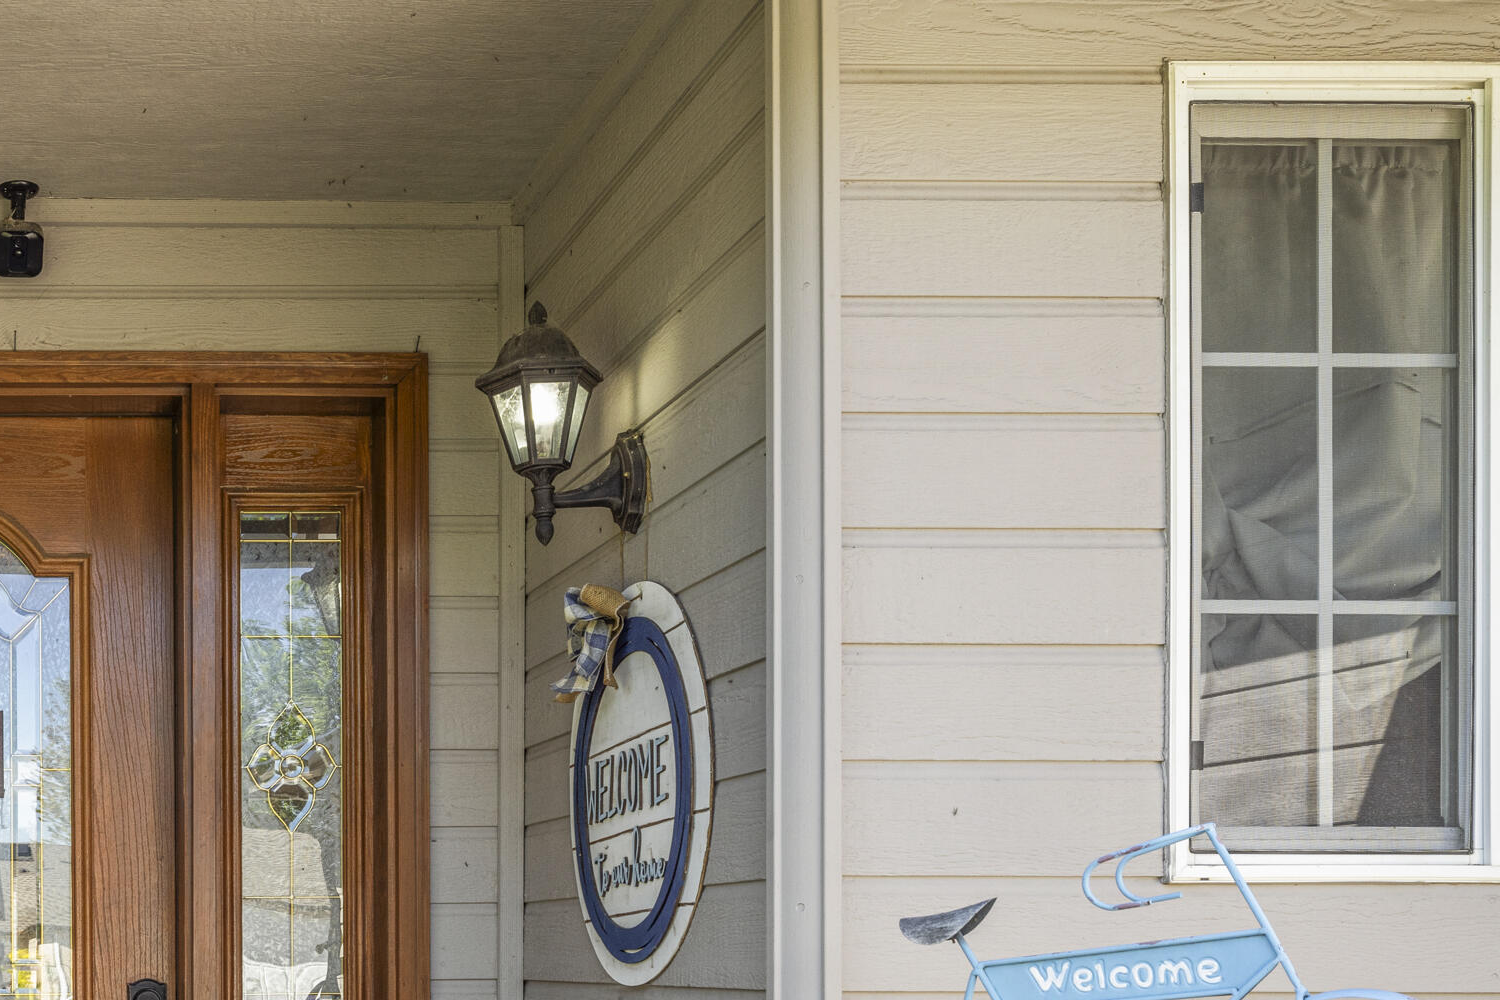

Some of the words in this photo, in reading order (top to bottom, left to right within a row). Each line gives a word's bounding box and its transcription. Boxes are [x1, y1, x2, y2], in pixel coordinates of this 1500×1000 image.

[584, 734, 670, 826] WELCOME
[594, 851, 612, 898] To
[612, 856, 632, 888] our
[631, 825, 669, 888] home
[1028, 958, 1223, 992] Welcome
